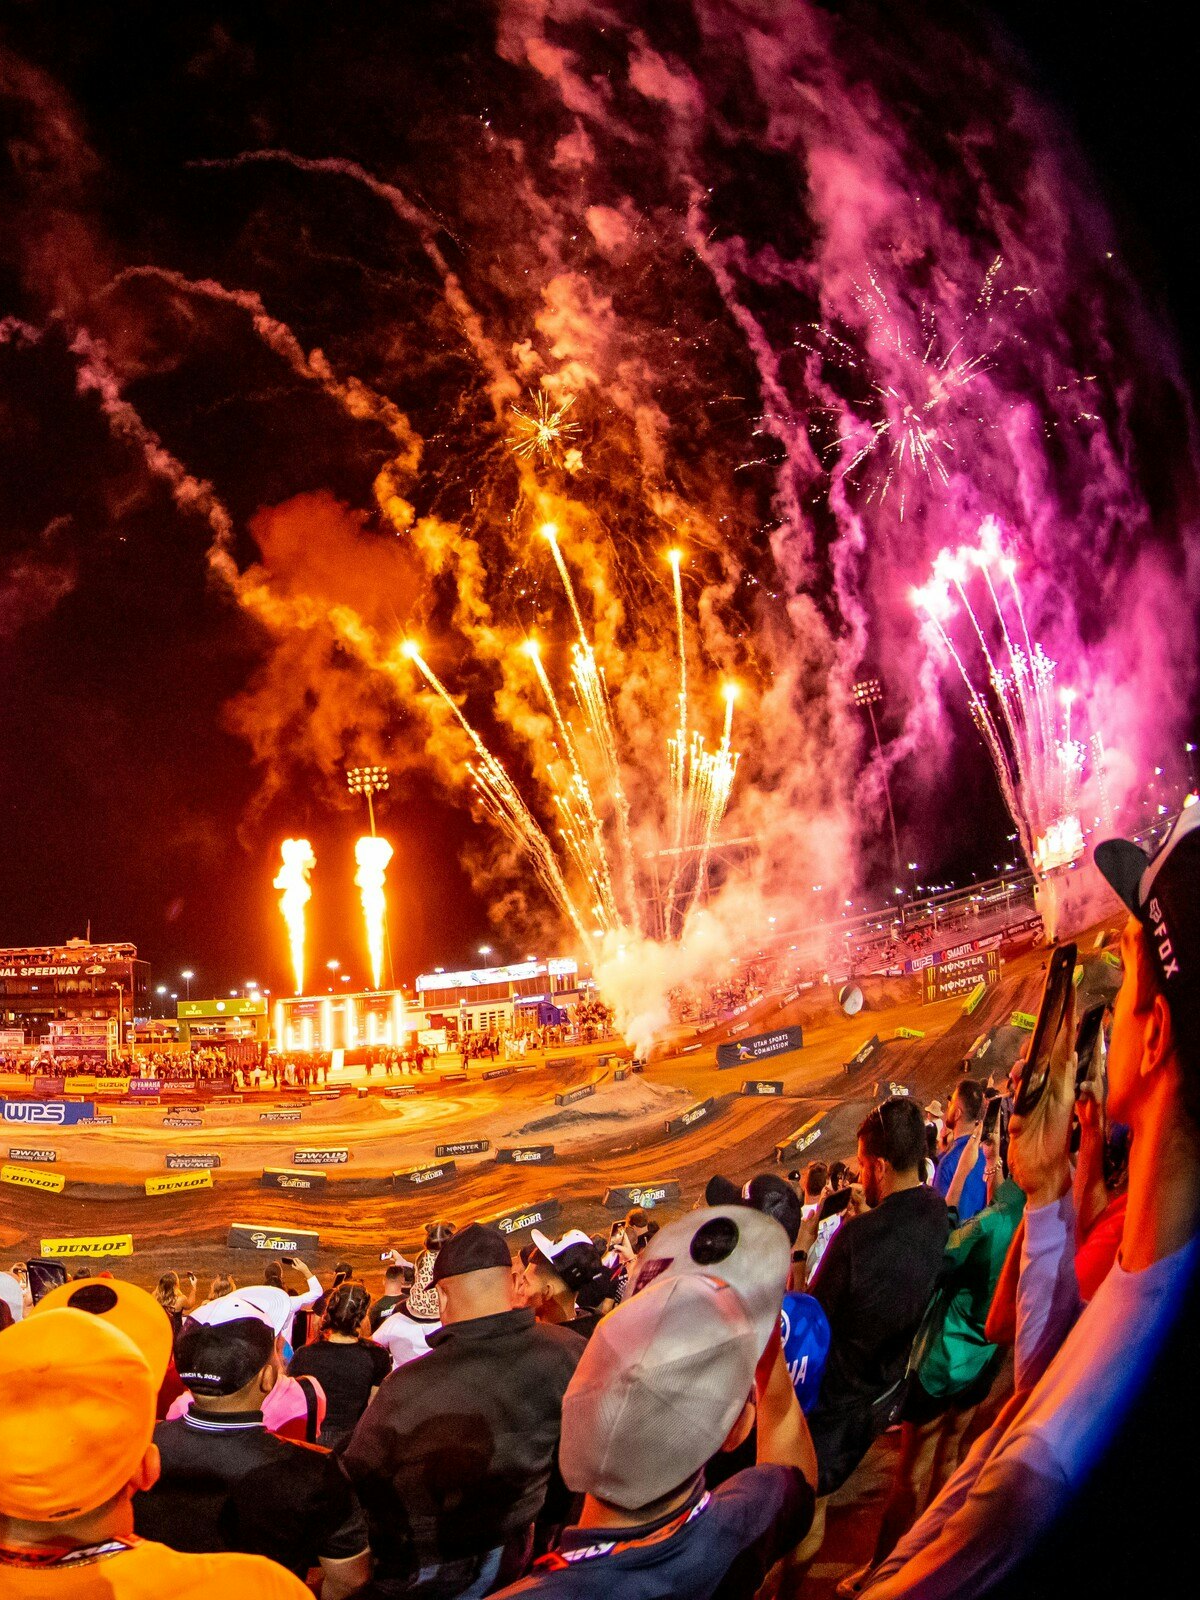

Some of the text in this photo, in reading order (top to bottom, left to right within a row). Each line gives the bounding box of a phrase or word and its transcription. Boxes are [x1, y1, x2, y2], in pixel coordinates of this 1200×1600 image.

[1153, 925, 1180, 980] FOX
[911, 954, 934, 971] WPS
[939, 956, 984, 974] MONSTER
[20, 965, 81, 976] SPEEDWAY
[939, 974, 985, 992] MONSTER
[753, 1033, 789, 1049] UTAH SPORTS
[754, 1040, 789, 1056] COMMISSION
[4, 1103, 66, 1124] WPS
[446, 1144, 480, 1152] MONSTER
[515, 1153, 541, 1161] HARDER
[10, 1175, 60, 1189] DUNLOP
[281, 1180, 311, 1188] HARDER
[415, 1169, 444, 1184] HARDER
[157, 1178, 209, 1191] DUNLOP
[505, 1212, 542, 1234] HARDER
[55, 1241, 127, 1254] DUNLOP
[256, 1240, 297, 1250] HARDER
